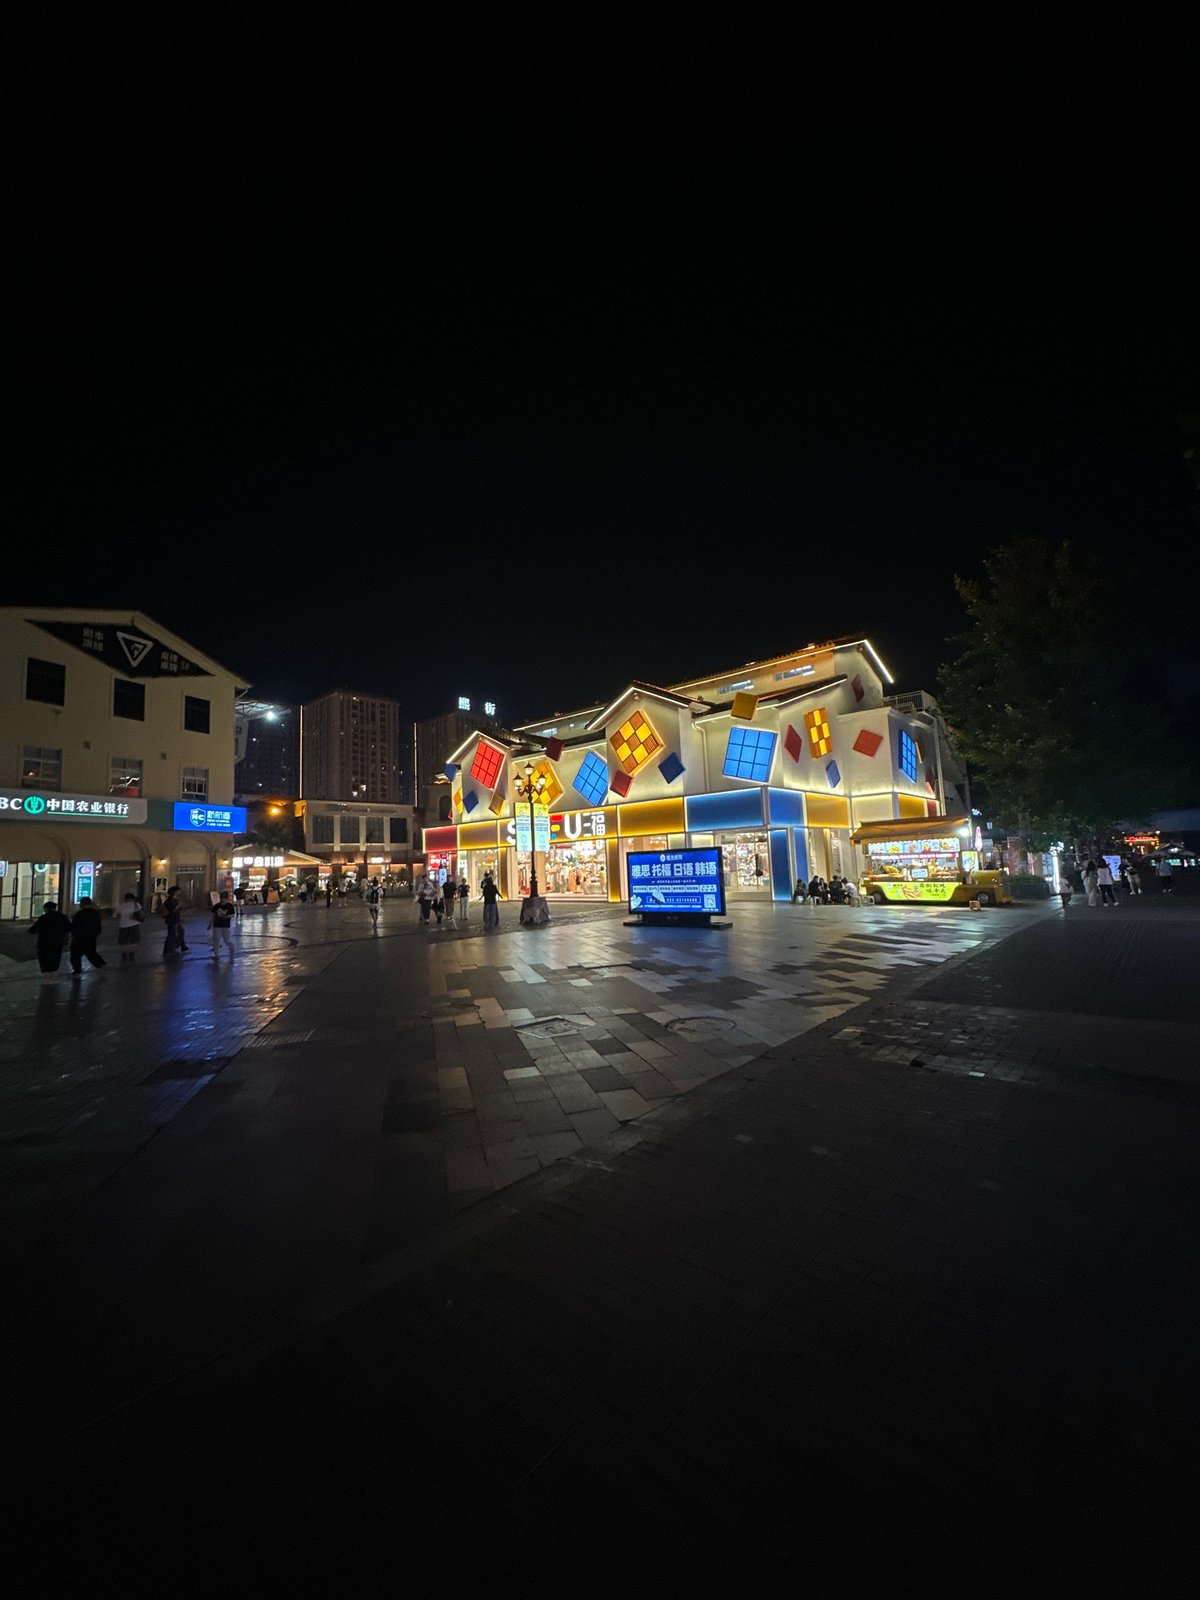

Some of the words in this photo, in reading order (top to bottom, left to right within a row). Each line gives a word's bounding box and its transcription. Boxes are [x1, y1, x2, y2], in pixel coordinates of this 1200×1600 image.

[46, 798, 129, 815] 中国农业银行
[582, 811, 605, 837] 三福
[631, 864, 651, 877] 雅思
[652, 863, 672, 877] 托福
[673, 862, 694, 876] 日语
[695, 861, 717, 876] 韩语
